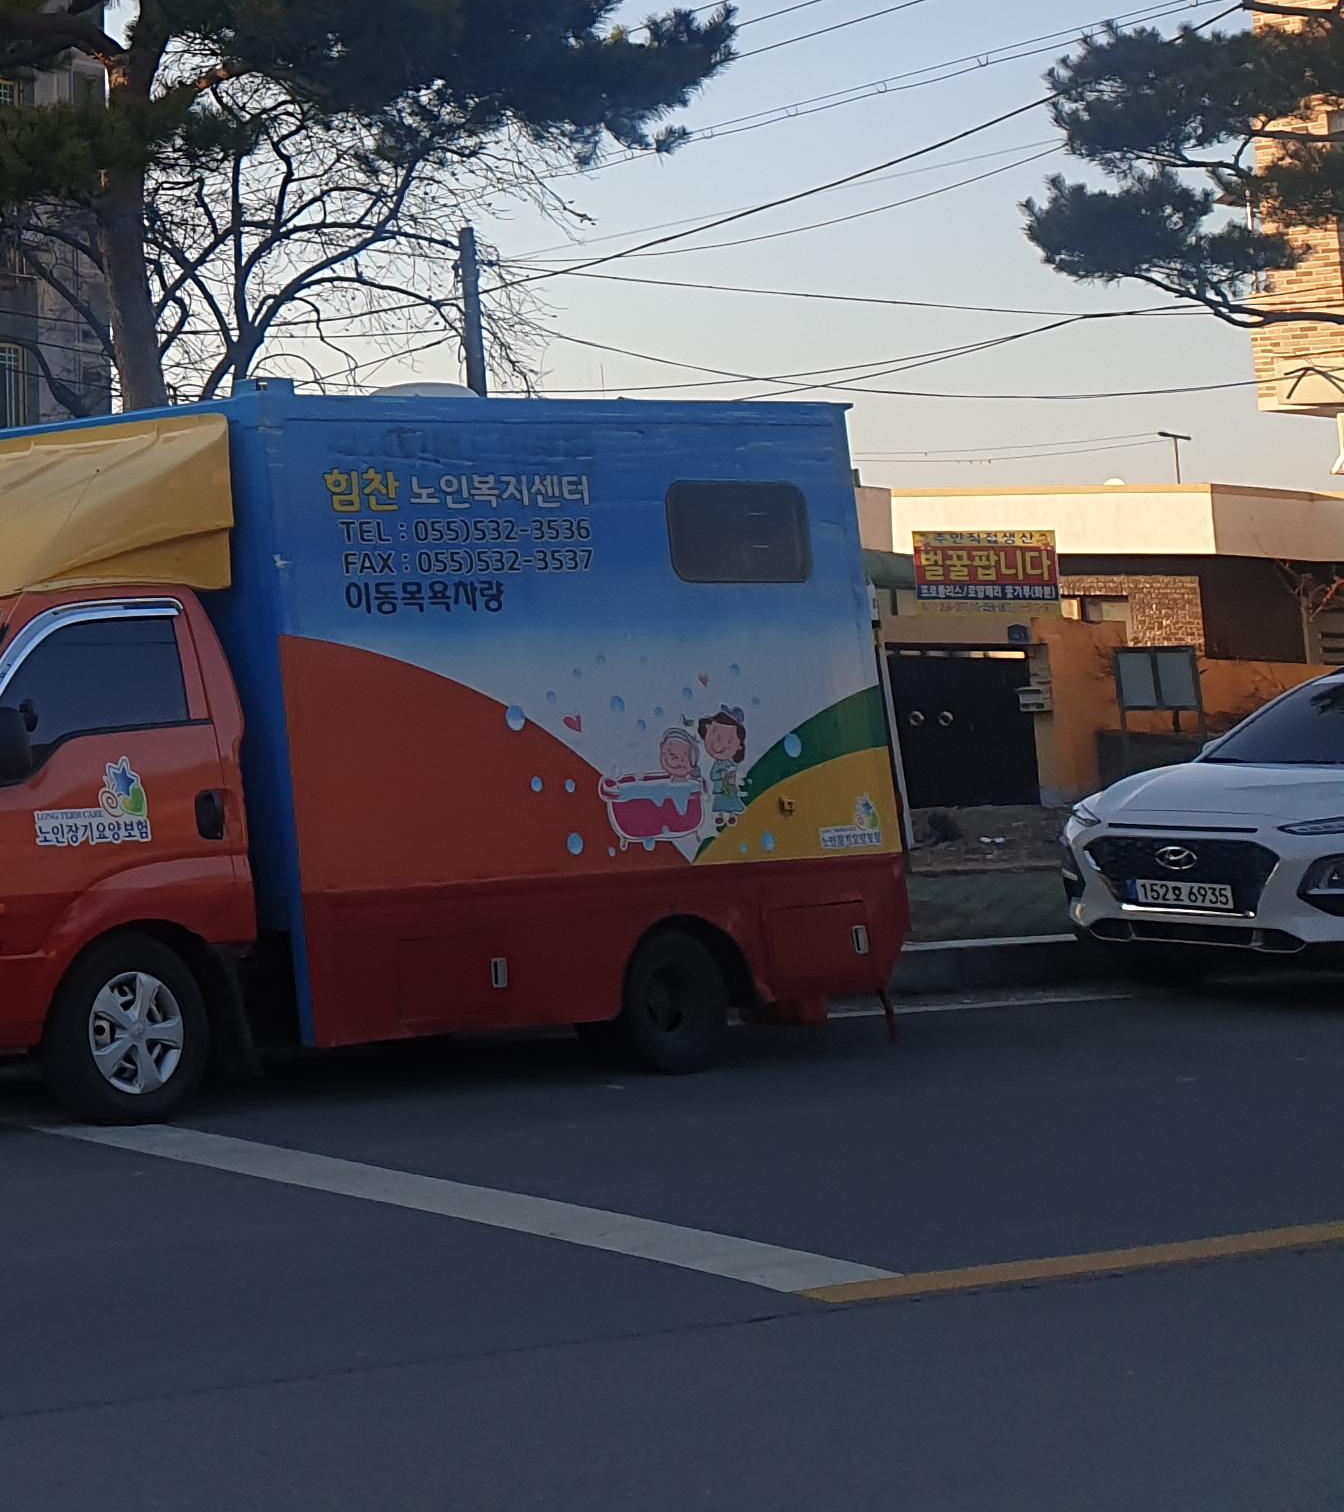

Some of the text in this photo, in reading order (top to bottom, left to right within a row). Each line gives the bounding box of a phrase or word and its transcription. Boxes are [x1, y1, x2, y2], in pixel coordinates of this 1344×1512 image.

[322, 467, 591, 512] 힘찬 노인복지센터
[340, 520, 392, 543] TEL
[415, 519, 591, 542] 055)532-3536
[343, 552, 396, 574] FAX
[417, 549, 593, 573] 055)532-3537
[920, 549, 1051, 581] 벌꿀팝니다
[345, 580, 504, 614] 이동목욕차량
[38, 819, 149, 844] 노인장기요양보험
[1188, 885, 1229, 905] 6935
